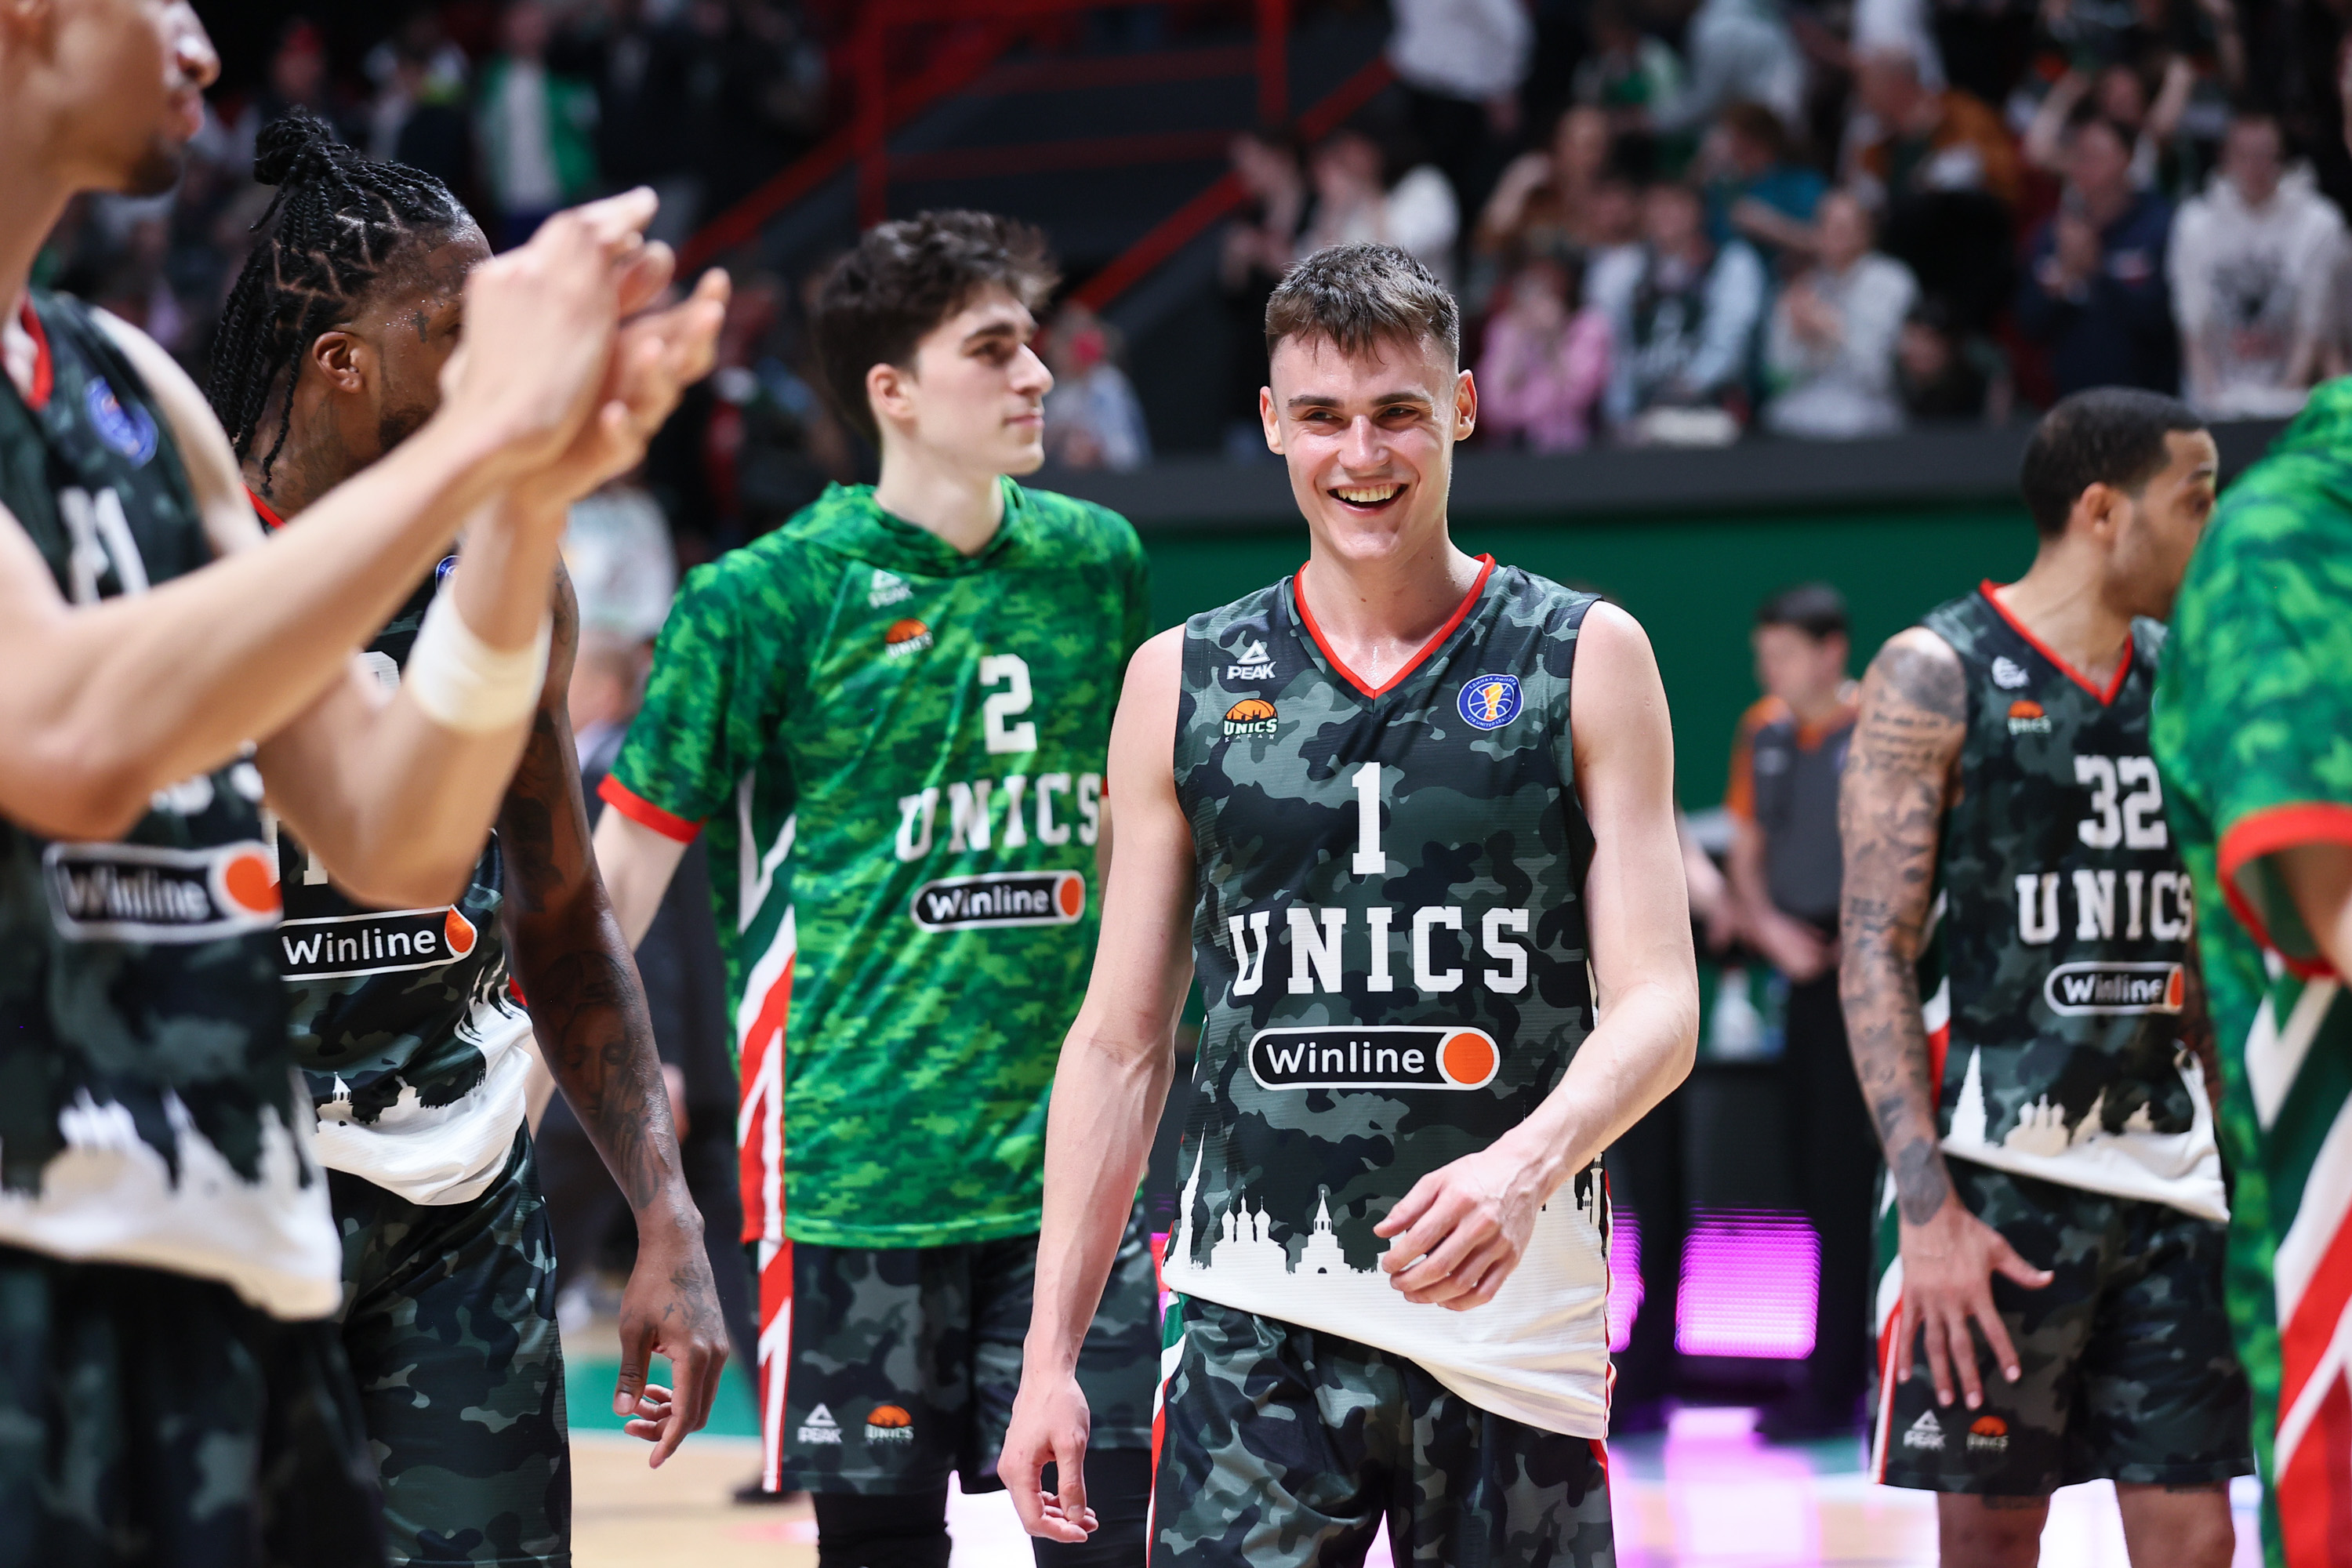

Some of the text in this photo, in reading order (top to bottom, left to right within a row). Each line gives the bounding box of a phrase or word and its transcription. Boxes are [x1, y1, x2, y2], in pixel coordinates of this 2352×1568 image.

[1226, 661, 1277, 680] PEAK
[979, 653, 1037, 754] 2
[1224, 718, 1278, 736] UNICS
[895, 772, 1102, 863] UNICS
[1352, 761, 1386, 875] 1
[2073, 755, 2168, 850] 32
[925, 887, 1049, 921] Winline
[2016, 869, 2193, 944] UNICS
[281, 925, 437, 966] Winline
[1228, 906, 1530, 996] UNICS
[1265, 1041, 1425, 1074] Winline
[865, 1424, 914, 1439] UNICS
